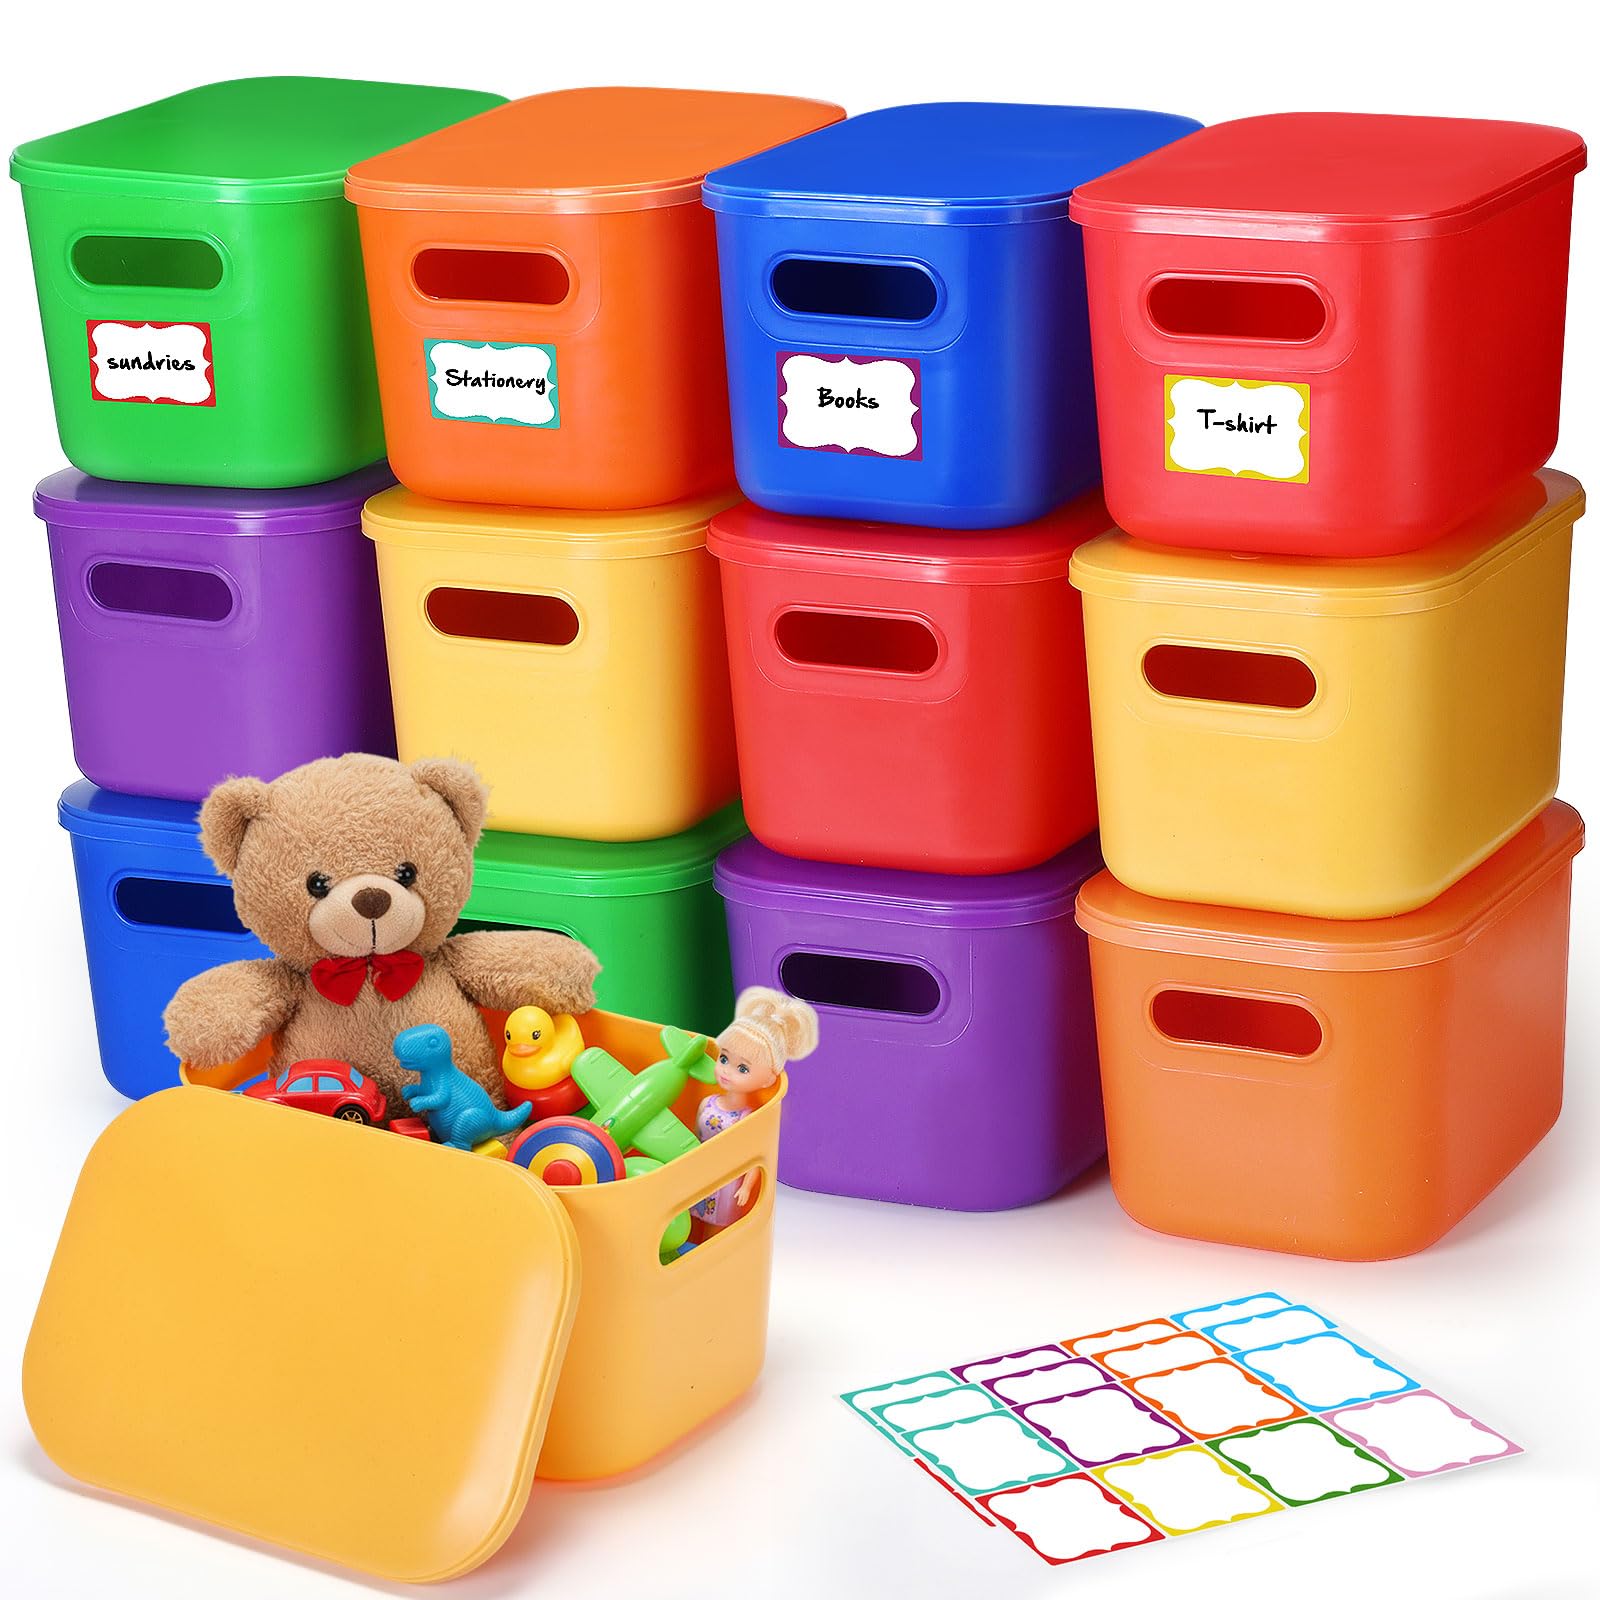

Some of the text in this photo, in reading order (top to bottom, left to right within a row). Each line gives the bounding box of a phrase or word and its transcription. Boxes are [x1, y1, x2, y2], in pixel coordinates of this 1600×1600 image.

[107, 351, 195, 371] sundries
[445, 369, 546, 395] Stationery
[817, 387, 879, 410] Books
[1197, 409, 1277, 434] T-shirt
